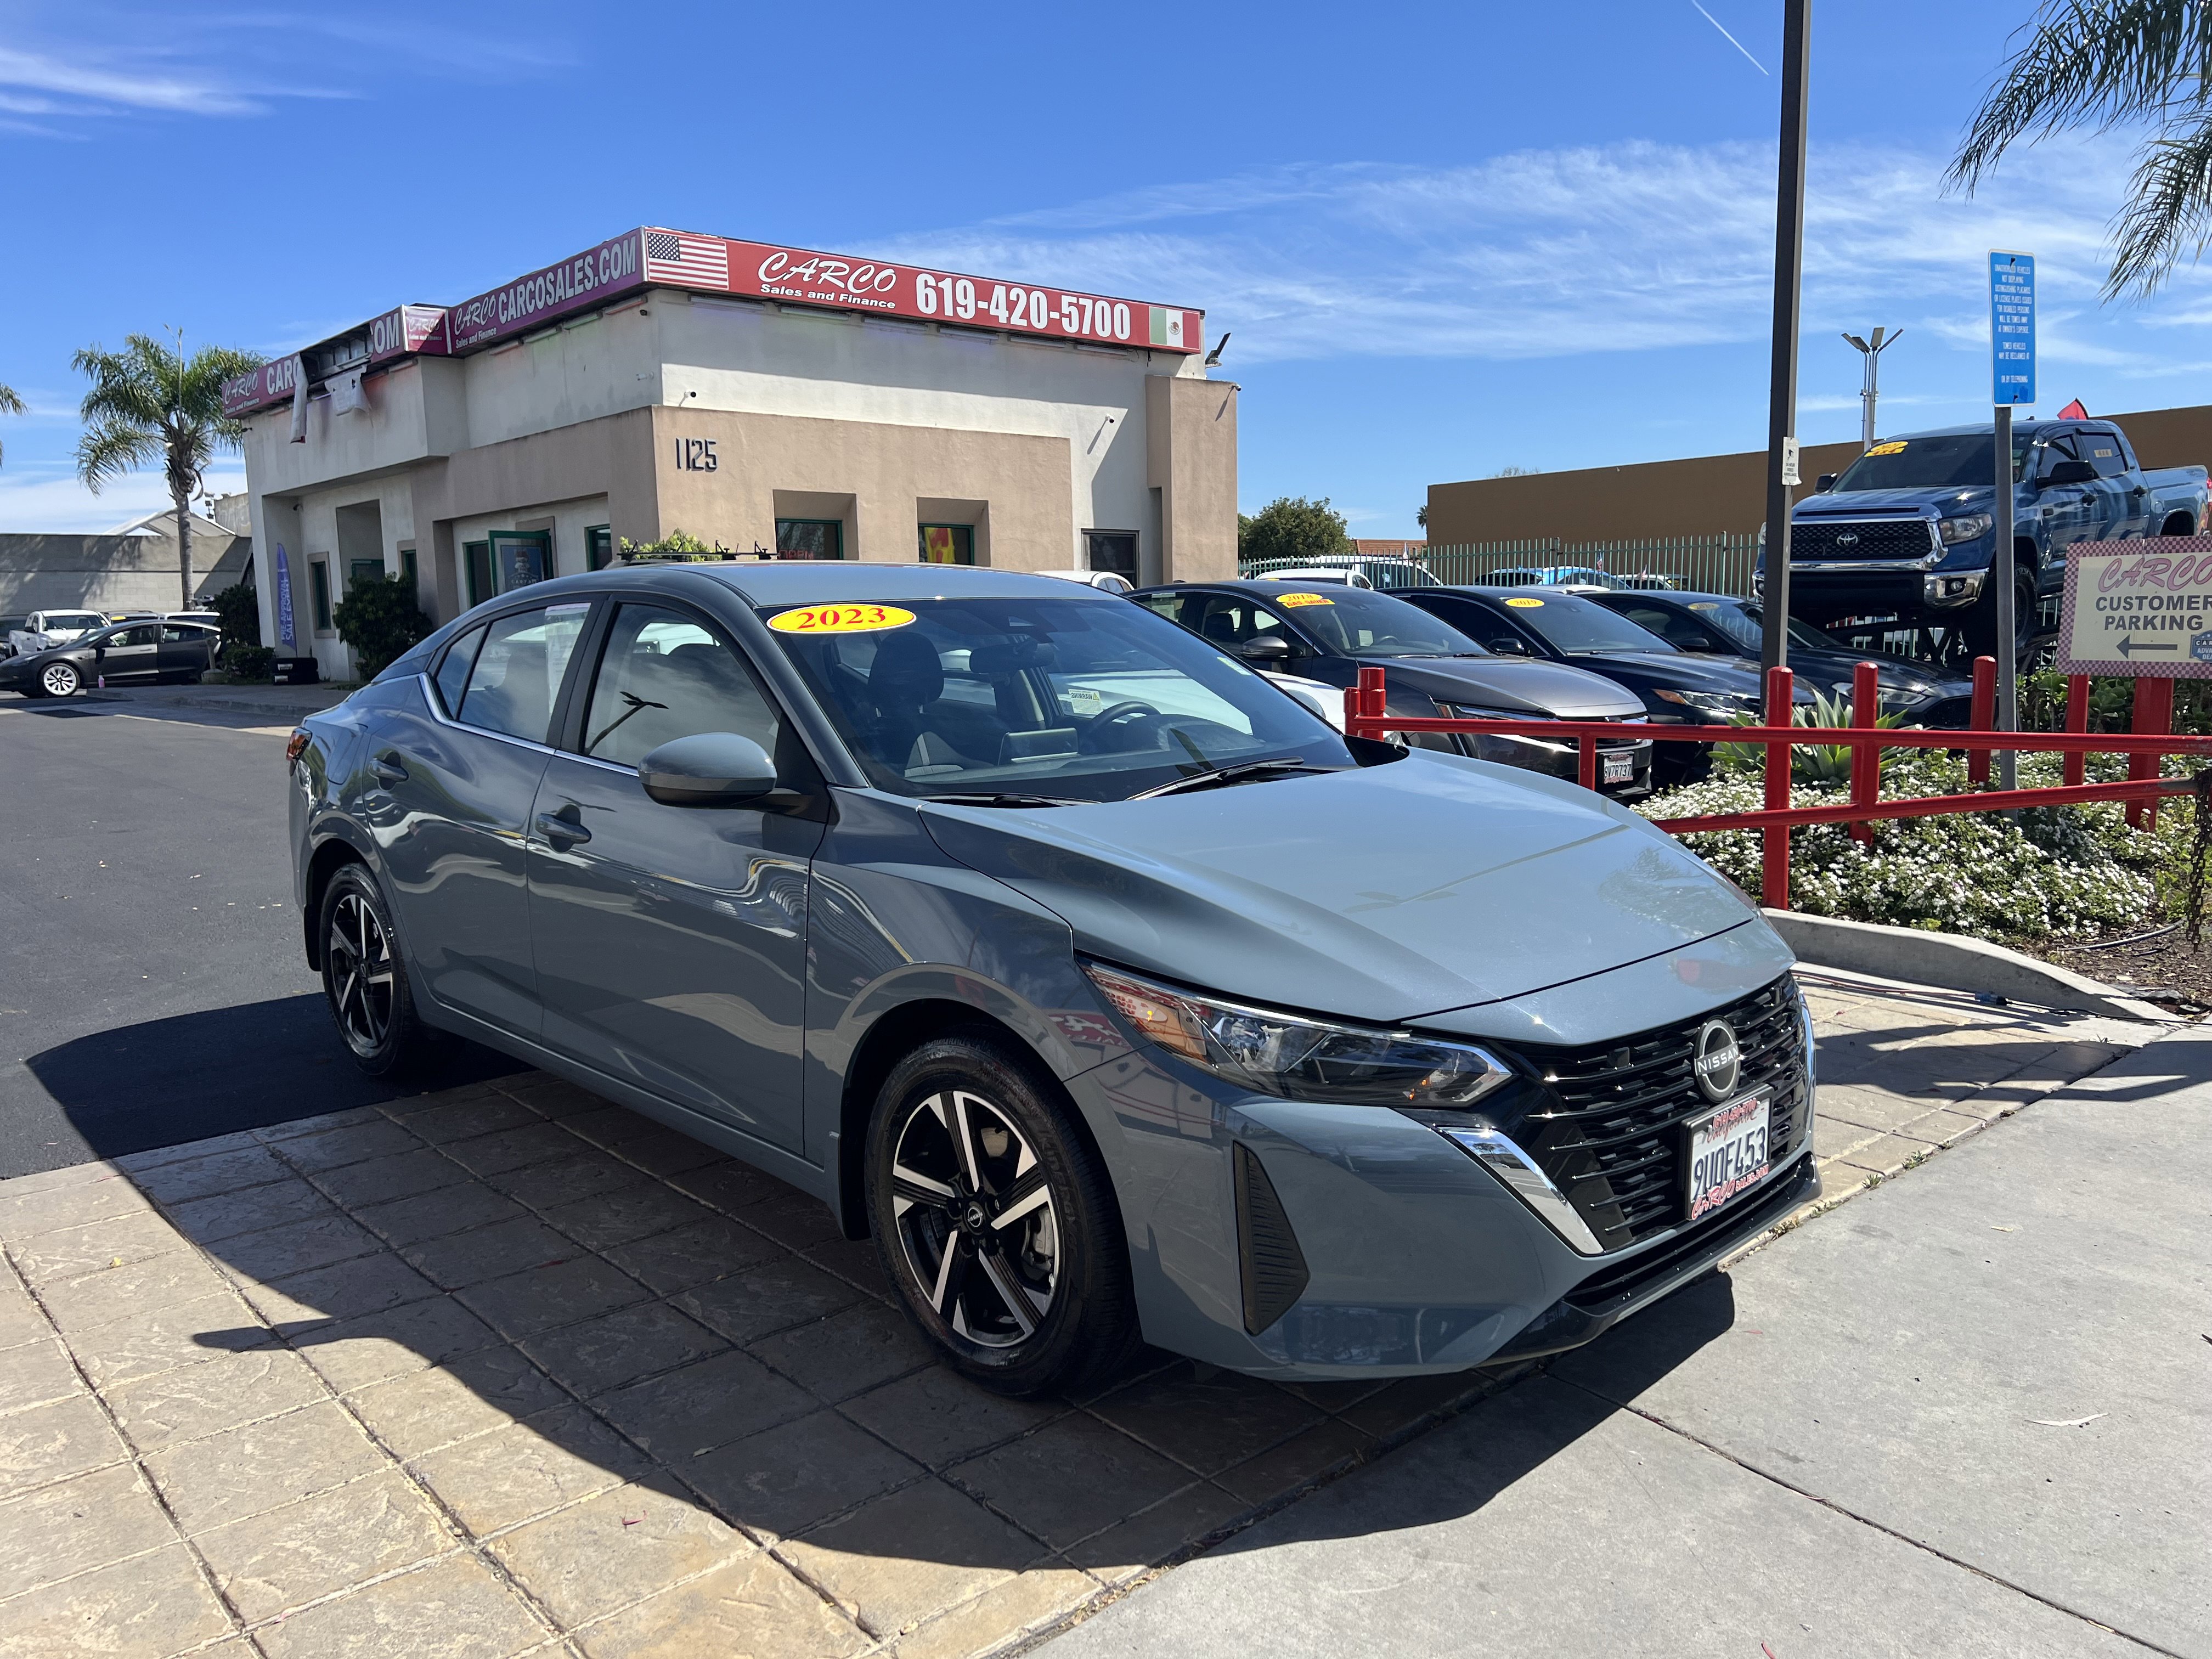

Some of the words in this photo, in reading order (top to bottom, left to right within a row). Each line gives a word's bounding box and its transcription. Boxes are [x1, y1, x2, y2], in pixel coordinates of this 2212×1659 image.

[454, 294, 496, 335] CARCO
[498, 236, 636, 324] CARCOSALES.COM
[758, 251, 897, 294] CARCO
[760, 284, 803, 297] Sales
[807, 291, 835, 301] and
[839, 294, 896, 308] Finance
[916, 273, 1131, 340] 619-420-5700
[370, 312, 399, 354] OM
[456, 337, 468, 349] Sales
[469, 333, 478, 345] and
[478, 327, 496, 340] Finance
[225, 372, 258, 405] CARCO
[675, 438, 717, 472] 1125
[2098, 555, 2212, 592] CARCO
[797, 607, 886, 629] 2023
[2096, 595, 2212, 612] CUSTOMER
[2104, 614, 2203, 630] PARKING
[1604, 764, 1632, 778] 8VZR737
[1697, 1045, 1739, 1073] NISSAN
[1692, 1177, 1736, 1220] CARCO
